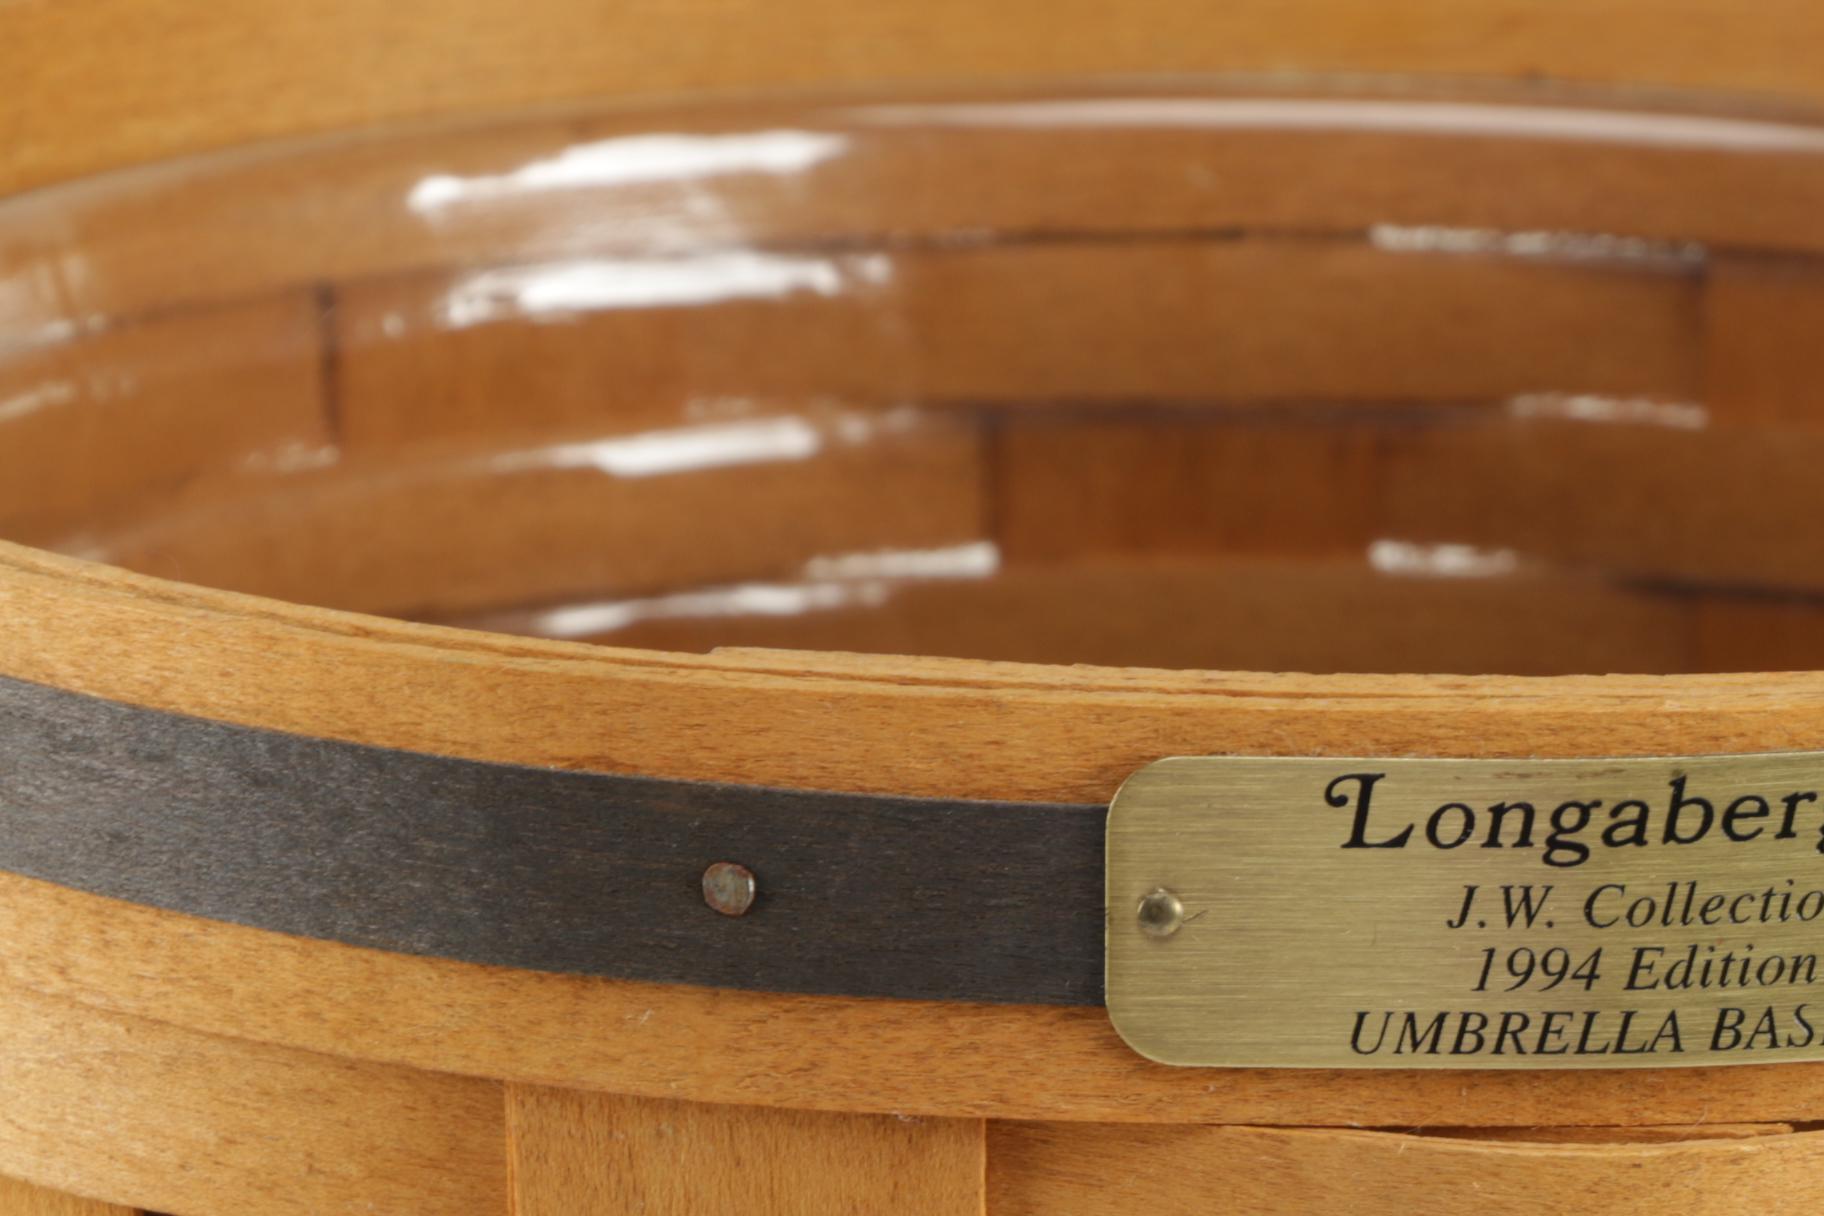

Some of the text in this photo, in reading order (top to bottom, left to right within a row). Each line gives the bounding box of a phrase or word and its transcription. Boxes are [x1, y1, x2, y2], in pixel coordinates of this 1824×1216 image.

[1446, 884, 1557, 930] J.W.
[1473, 944, 1818, 993] 1994 Edition
[1349, 1009, 1685, 1056] UMBRELLA
